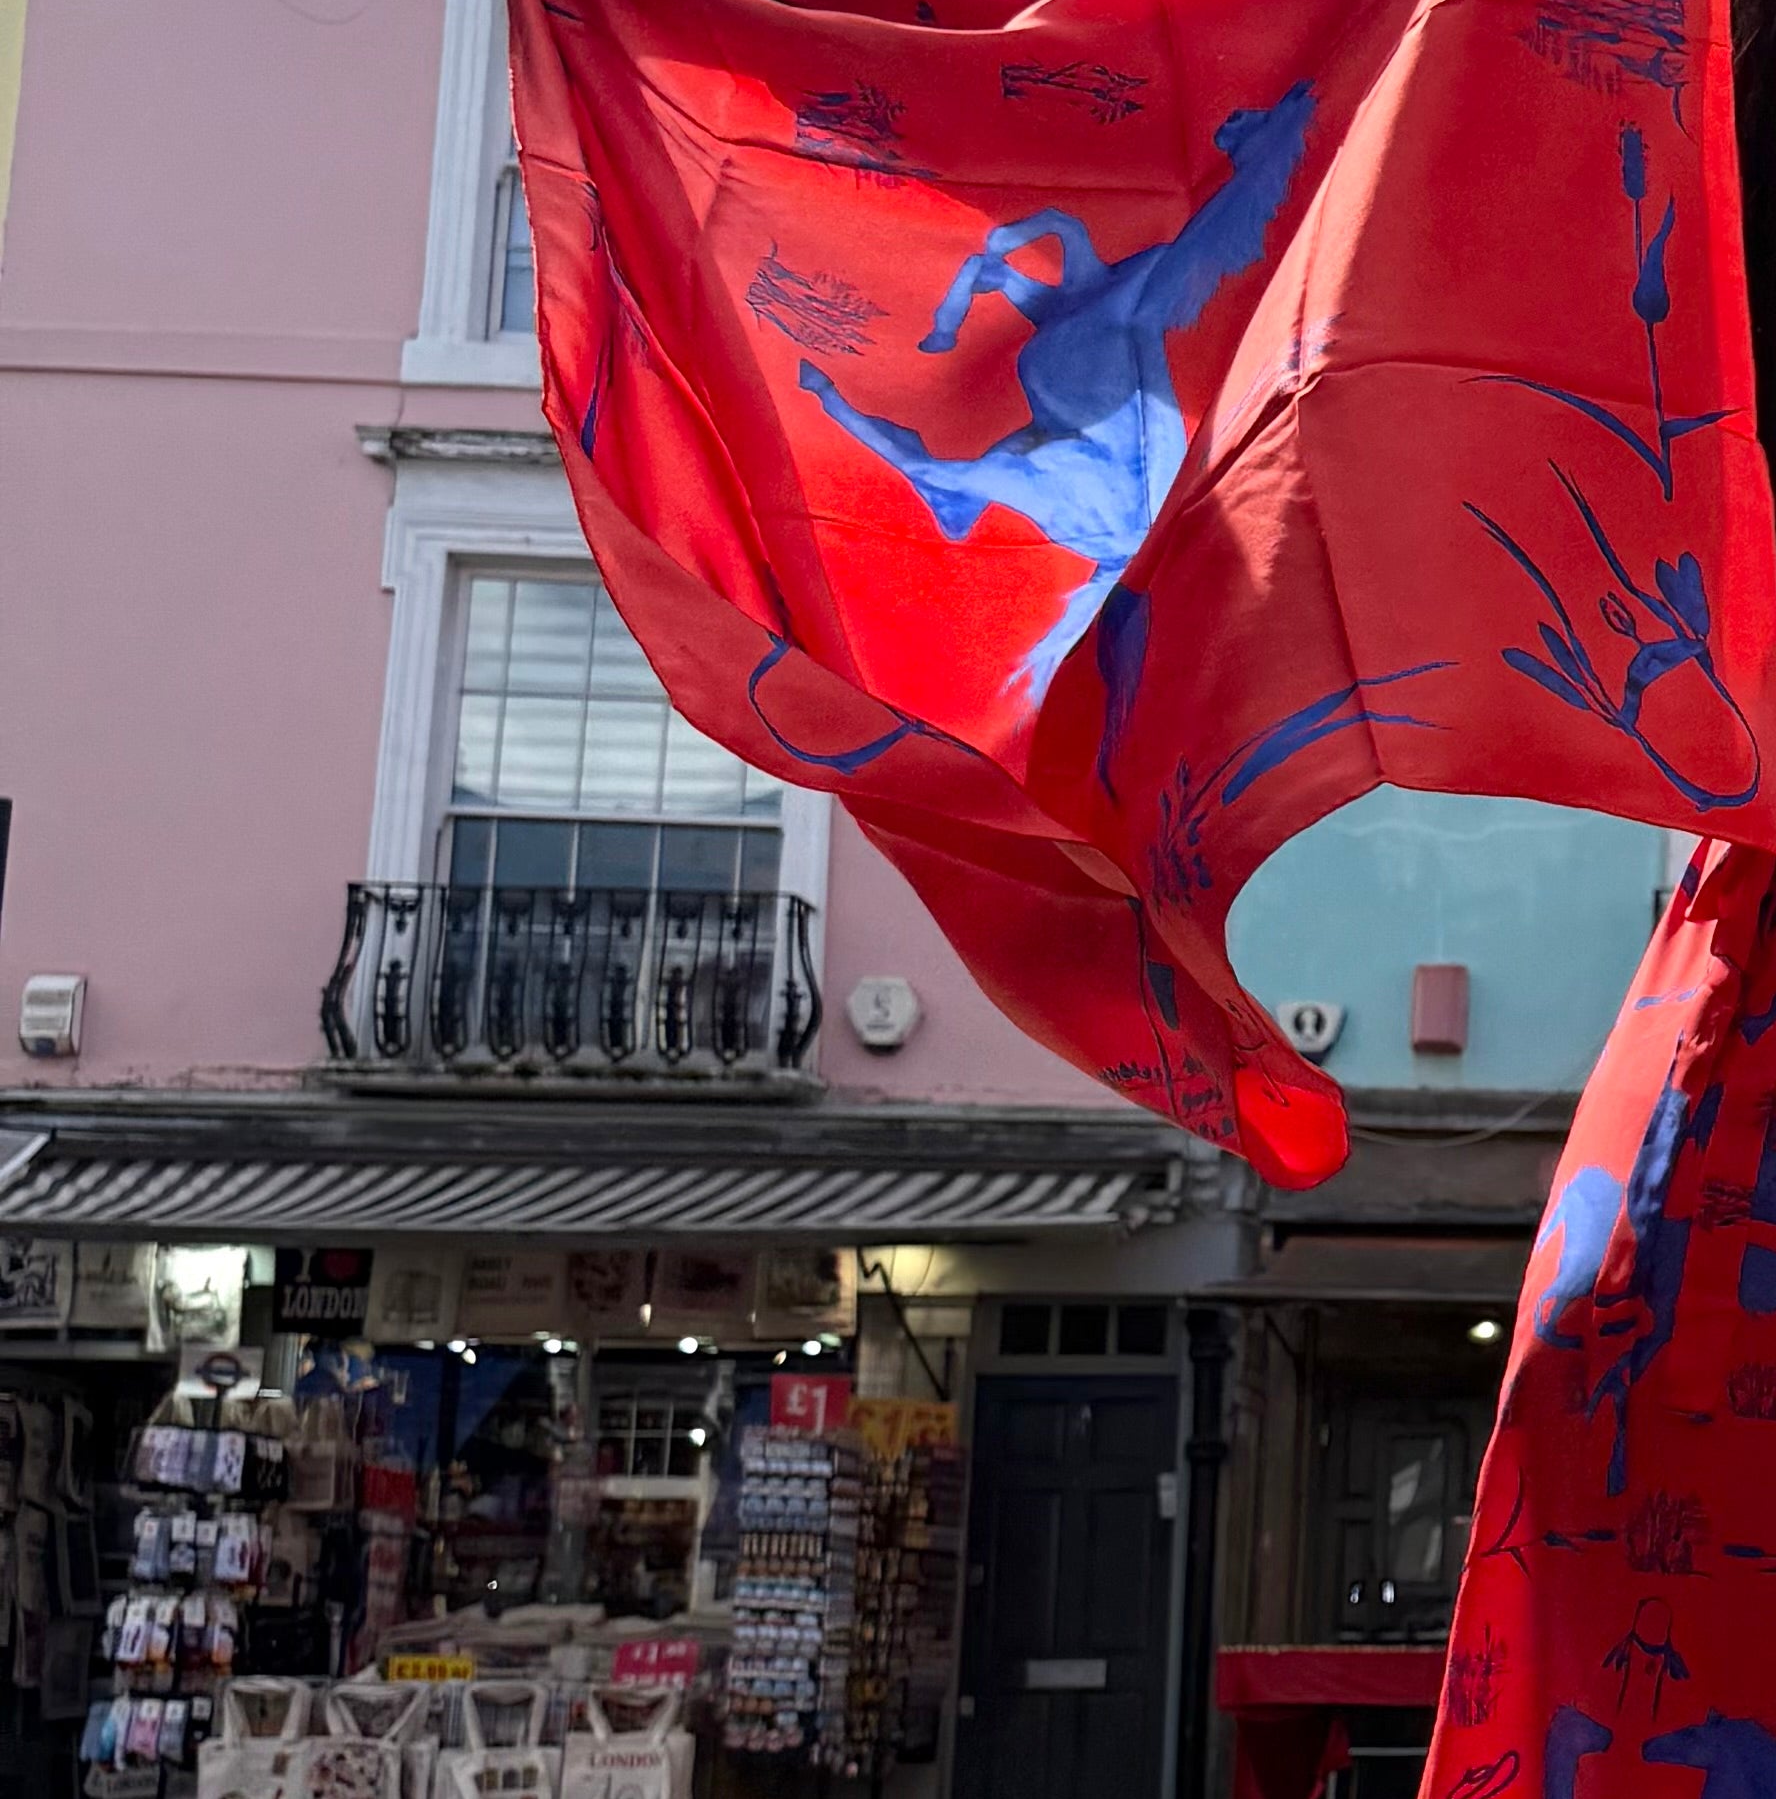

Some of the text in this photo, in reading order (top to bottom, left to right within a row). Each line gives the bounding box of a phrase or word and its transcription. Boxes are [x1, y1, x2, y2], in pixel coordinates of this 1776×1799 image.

[281, 1283, 368, 1320] LONDON
[784, 1383, 829, 1438] £1
[589, 1751, 661, 1769] LONDON
